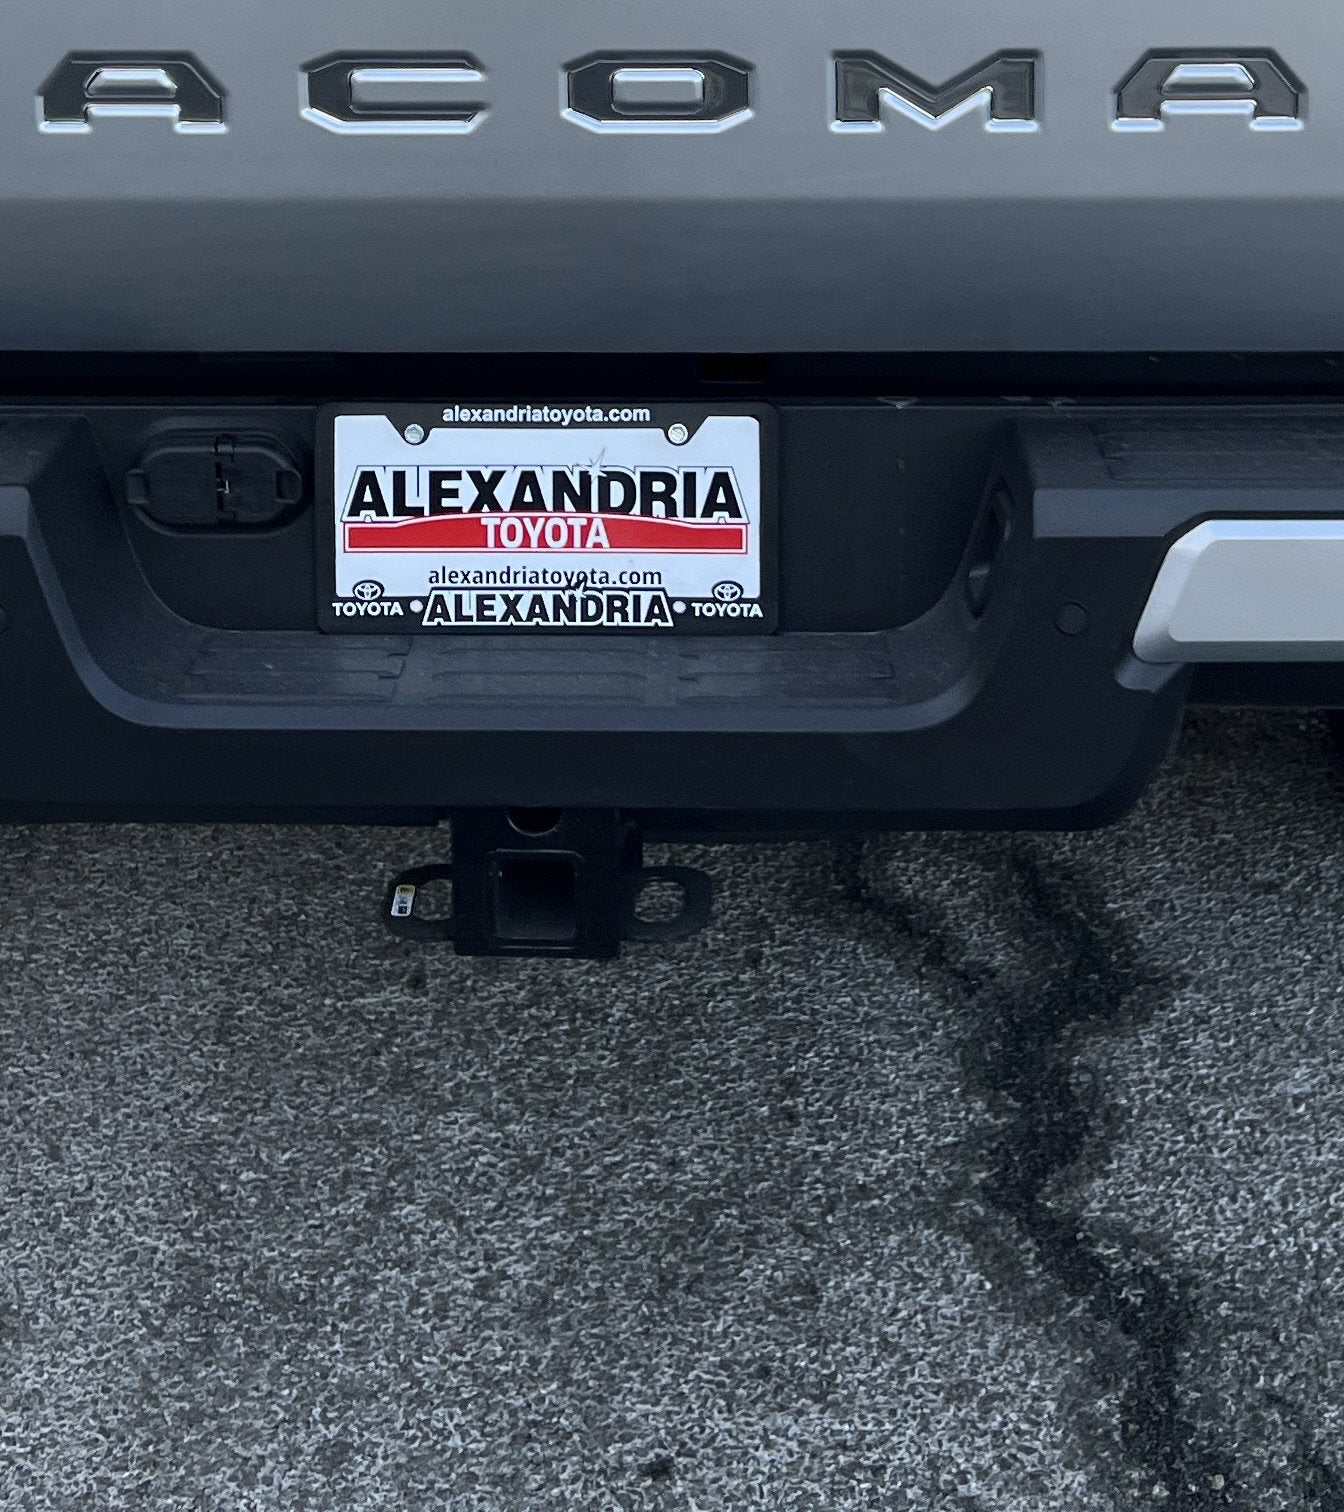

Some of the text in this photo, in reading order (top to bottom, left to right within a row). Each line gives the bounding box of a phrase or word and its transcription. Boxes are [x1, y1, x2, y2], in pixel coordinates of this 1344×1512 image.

[442, 405, 651, 426] alexandriatoyota.com
[346, 468, 743, 519] ALEXANDRIA
[480, 517, 611, 550] TOYOTA
[428, 566, 663, 590] alexandriatoyota.com
[332, 601, 404, 617] TOYOTA
[422, 589, 674, 627] ALEXANDRIA
[691, 602, 764, 619] TOYOTA
